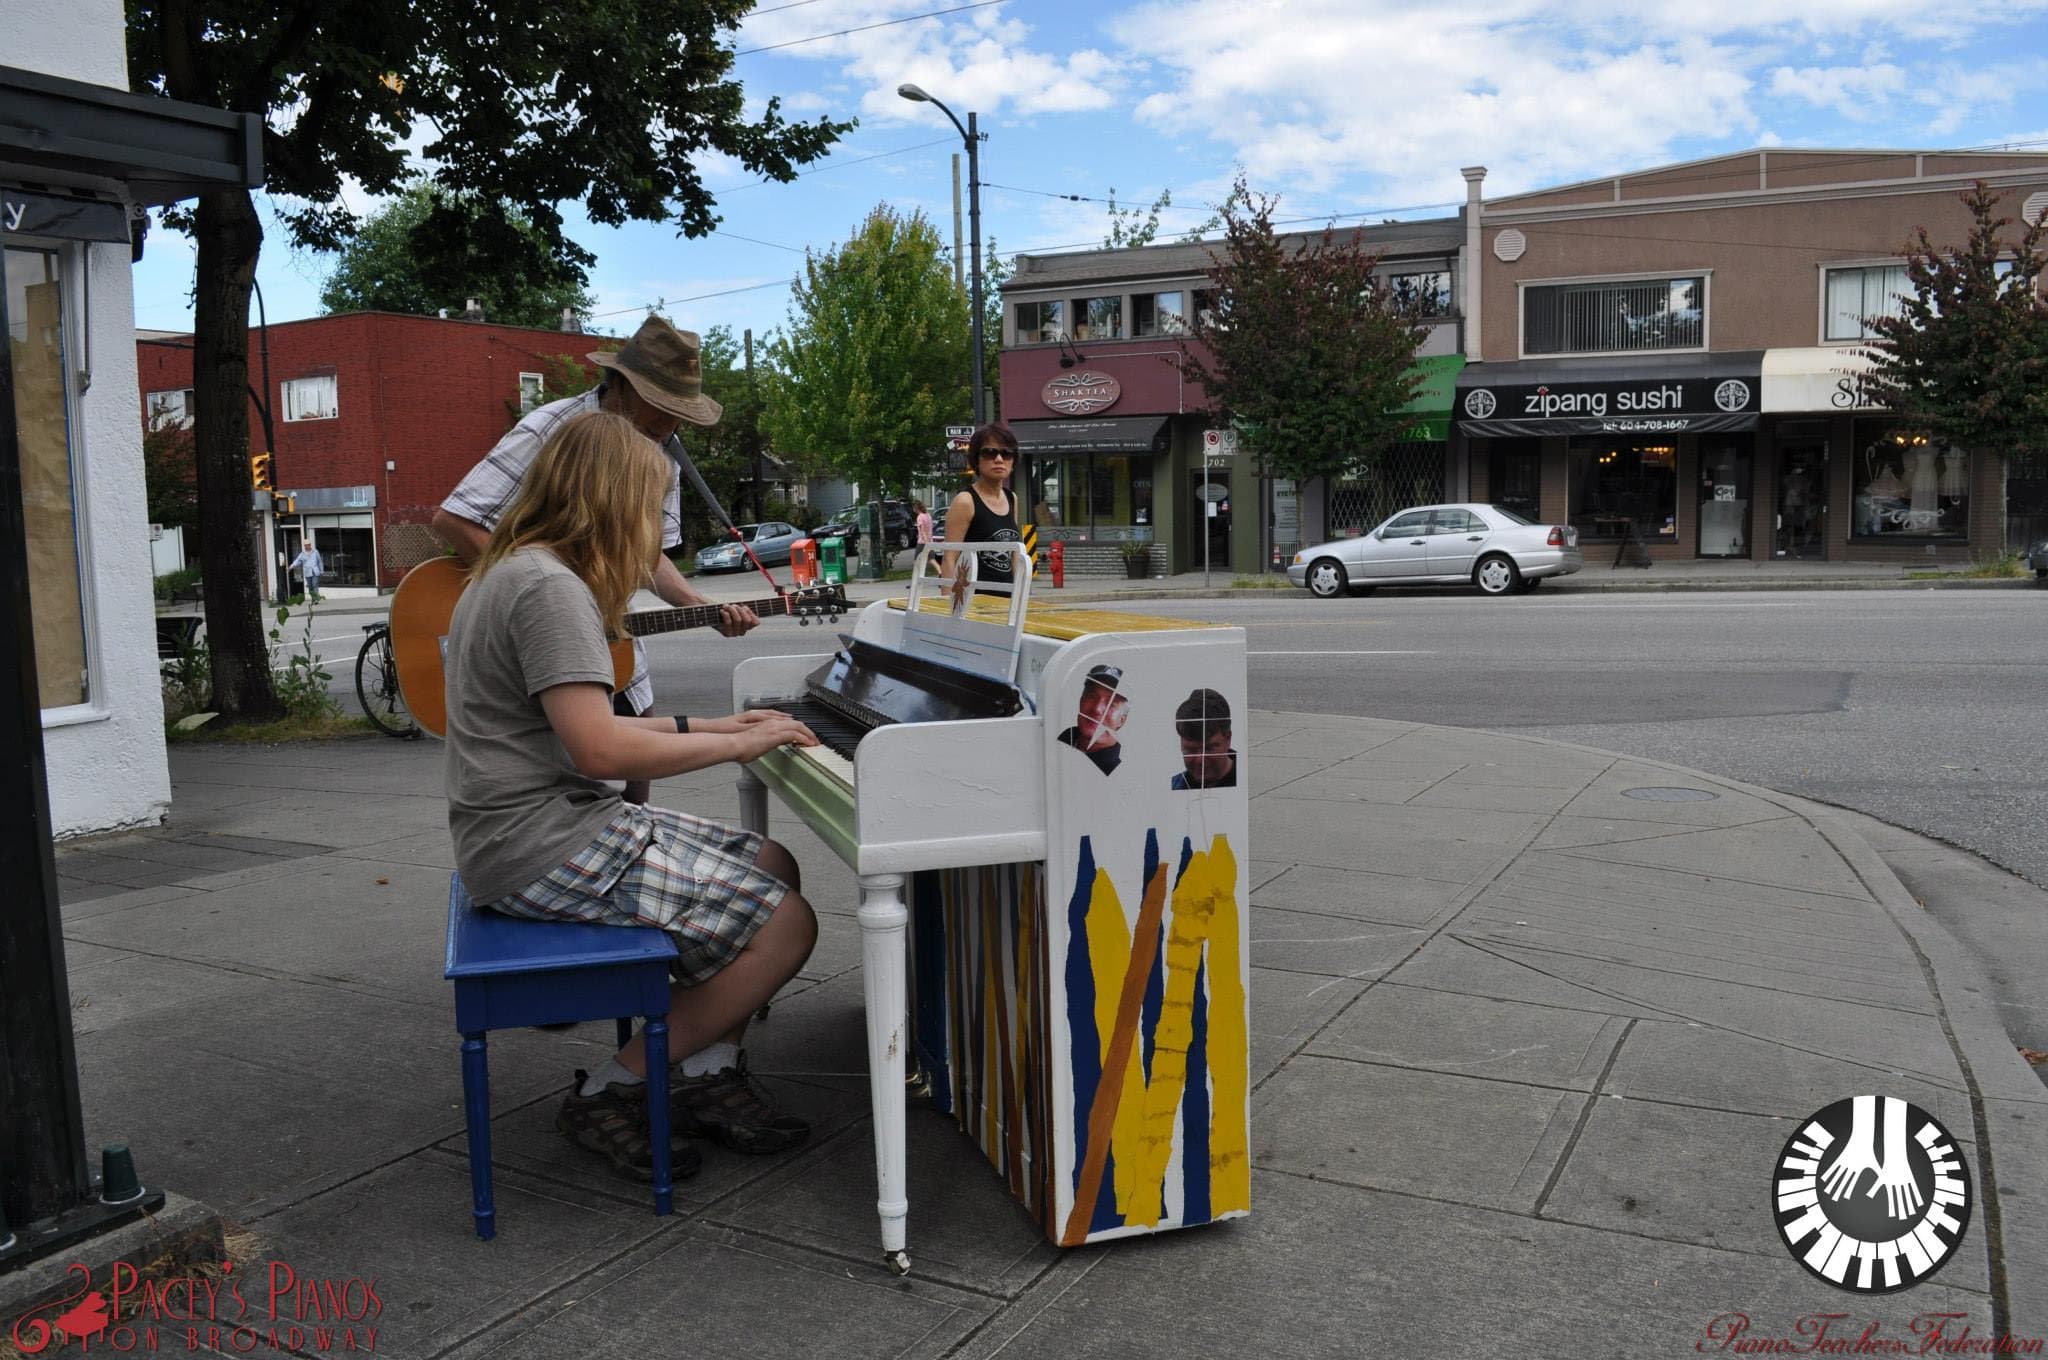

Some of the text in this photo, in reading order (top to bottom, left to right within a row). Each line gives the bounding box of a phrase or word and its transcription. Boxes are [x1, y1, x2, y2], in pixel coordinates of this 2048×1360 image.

[1054, 387, 1107, 397] SHAKTEA
[1524, 384, 1683, 418] zipang sushi
[1620, 420, 1688, 431] 604-708-1667
[1203, 458, 1225, 468] 702
